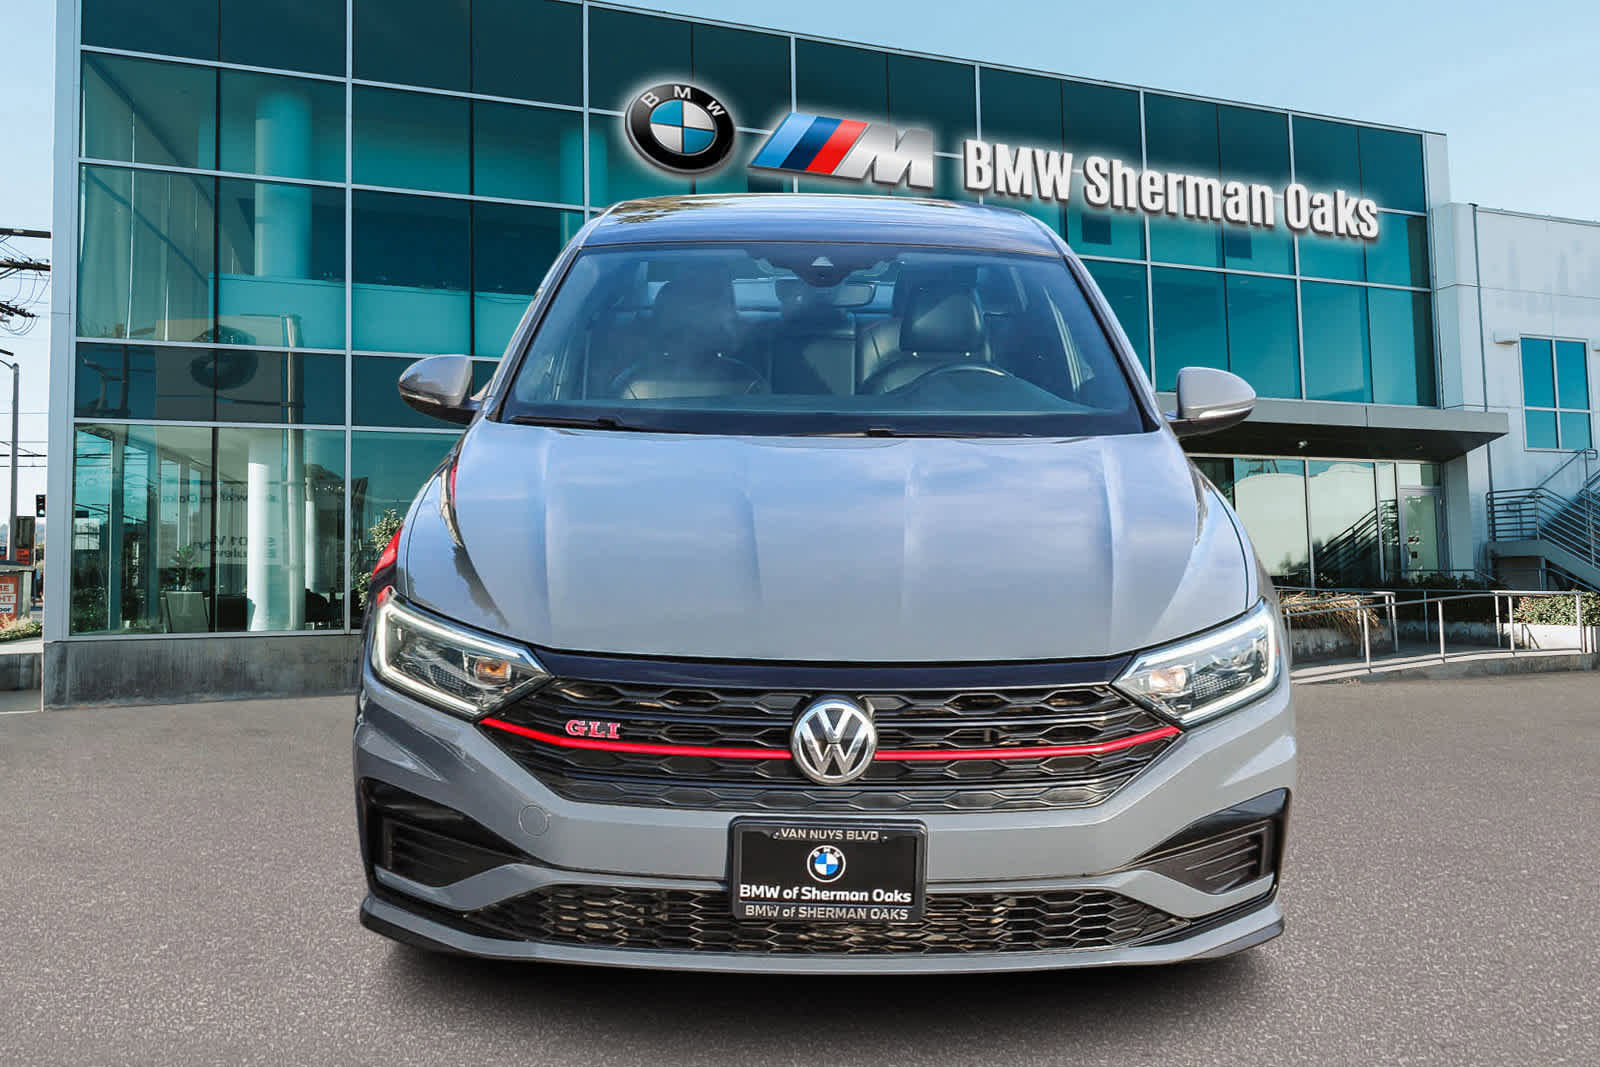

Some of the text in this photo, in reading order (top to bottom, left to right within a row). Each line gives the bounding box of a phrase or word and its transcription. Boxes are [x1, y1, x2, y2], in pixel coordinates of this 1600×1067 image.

[641, 84, 725, 117] BMW
[963, 138, 1380, 241] BMW Sherman Oaks
[565, 719, 621, 740] GLI
[797, 702, 874, 781] VW
[780, 828, 880, 841] VAN NUYS BLVD
[739, 884, 912, 903] BMW of Sherman Oaks
[745, 904, 909, 920] BMW of SHERMAN OAKS
